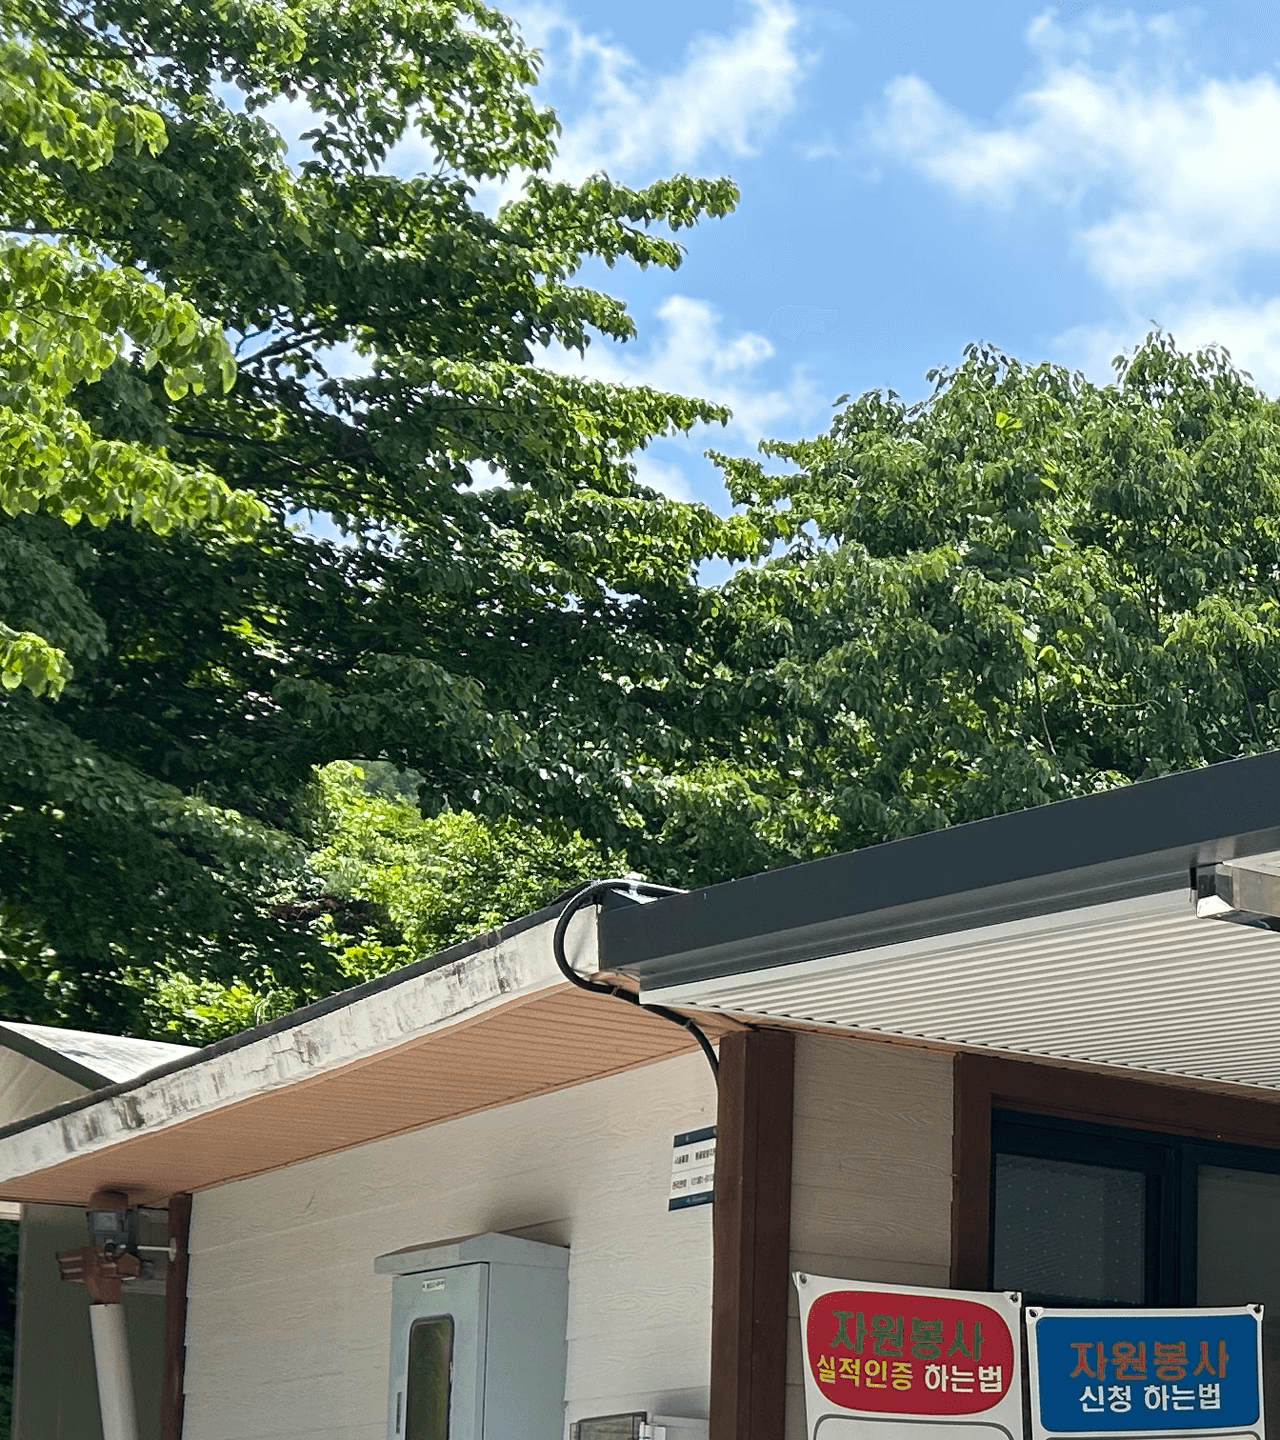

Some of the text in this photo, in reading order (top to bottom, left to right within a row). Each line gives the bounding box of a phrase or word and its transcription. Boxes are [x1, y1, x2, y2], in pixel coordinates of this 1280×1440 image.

[830, 1309, 985, 1362] 자원봉사
[816, 1355, 1003, 1395] 실적인증 하는법
[1069, 1339, 1230, 1382] 자원봉사
[1078, 1382, 1222, 1414] 신청 하는법
